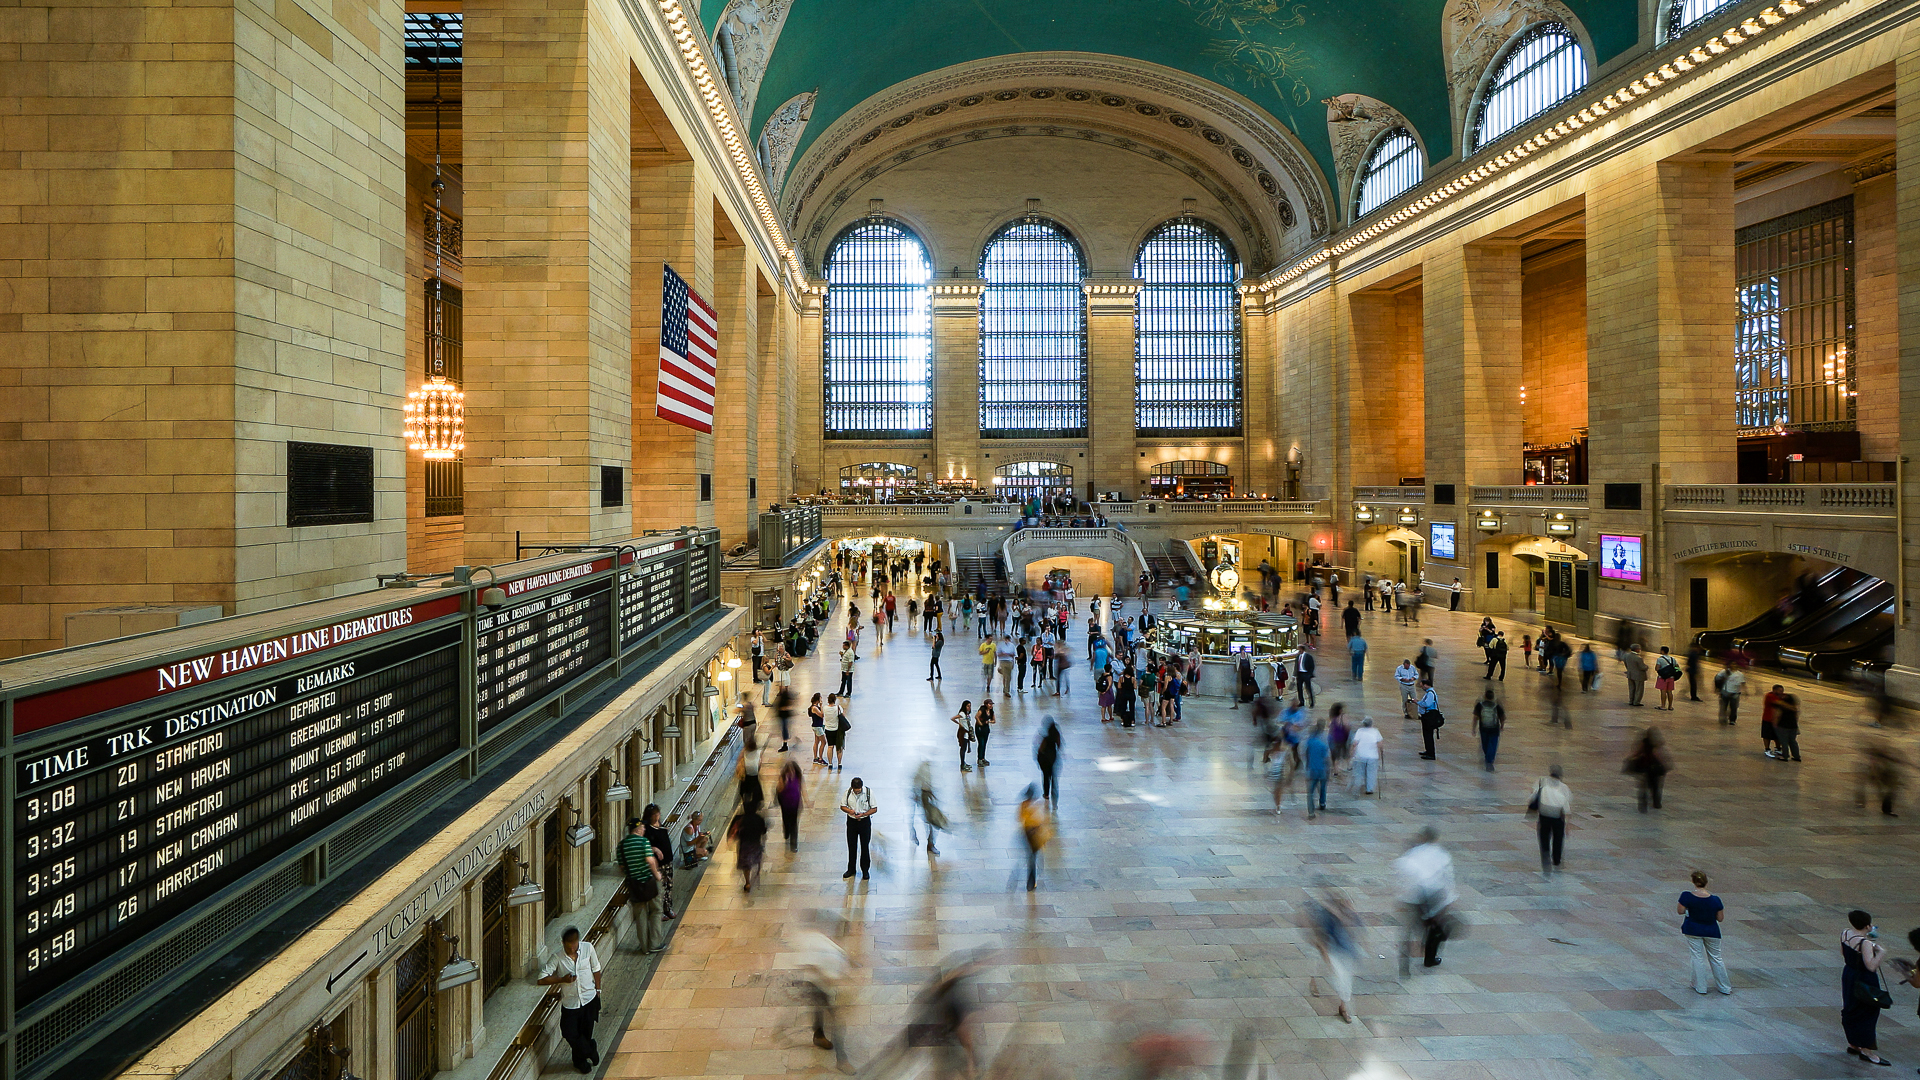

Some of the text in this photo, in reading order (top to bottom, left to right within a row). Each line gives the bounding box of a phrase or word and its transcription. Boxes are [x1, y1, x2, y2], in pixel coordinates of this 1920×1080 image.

[1192, 530, 1209, 538] TICKET
[1673, 540, 1757, 560] THE METLIFE BUILDING
[1788, 543, 1850, 563] 45TH STREET
[508, 562, 592, 596] NEW HAVEN LINE DEPARTURES
[478, 591, 571, 631] TIME TRK DESTINATION REMARKS
[507, 625, 516, 638] NEW
[517, 621, 530, 633] HAVEN
[158, 607, 413, 692] NEW HAVEN LINE DEPARTURES
[507, 640, 521, 654] SOUTH
[507, 658, 516, 671] NEW
[517, 652, 530, 667] HAVEN
[507, 669, 528, 688] STAMFORD
[507, 686, 526, 705] DANBURY
[26, 662, 355, 784] TIME TRK DESTINATION REMARKS
[28, 691, 336, 821] 3:08 20 STAMFORD DEPARTED
[28, 821, 75, 858] 3:32
[118, 797, 134, 821] 21
[156, 777, 183, 804] NEW
[191, 758, 230, 790] HAVEN
[290, 713, 341, 747] GREENWICH
[356, 701, 370, 719] 1ST
[374, 693, 393, 712] STOP
[28, 857, 75, 896] 3:35
[120, 829, 137, 853] 19
[156, 790, 223, 836] STAMFORD
[290, 747, 320, 774] MOUNT
[325, 730, 356, 757] VERNON
[371, 718, 384, 736] 1ST
[387, 709, 405, 728] STOP
[28, 893, 75, 934] 3:49
[120, 862, 137, 887] 17
[156, 840, 183, 869] NEW
[191, 812, 238, 850] CANAAN
[290, 778, 309, 800] RYE
[326, 762, 341, 782] 1ST
[346, 749, 366, 772] STOP
[28, 929, 75, 971] 3:58
[118, 896, 138, 923] 26
[156, 849, 223, 901] HARRISON
[290, 797, 320, 826] MOUNT
[325, 778, 357, 806] VERNON
[371, 763, 384, 782] 1ST
[388, 752, 406, 772] STOP
[373, 790, 545, 957] TICKET VENDING MACHINES
